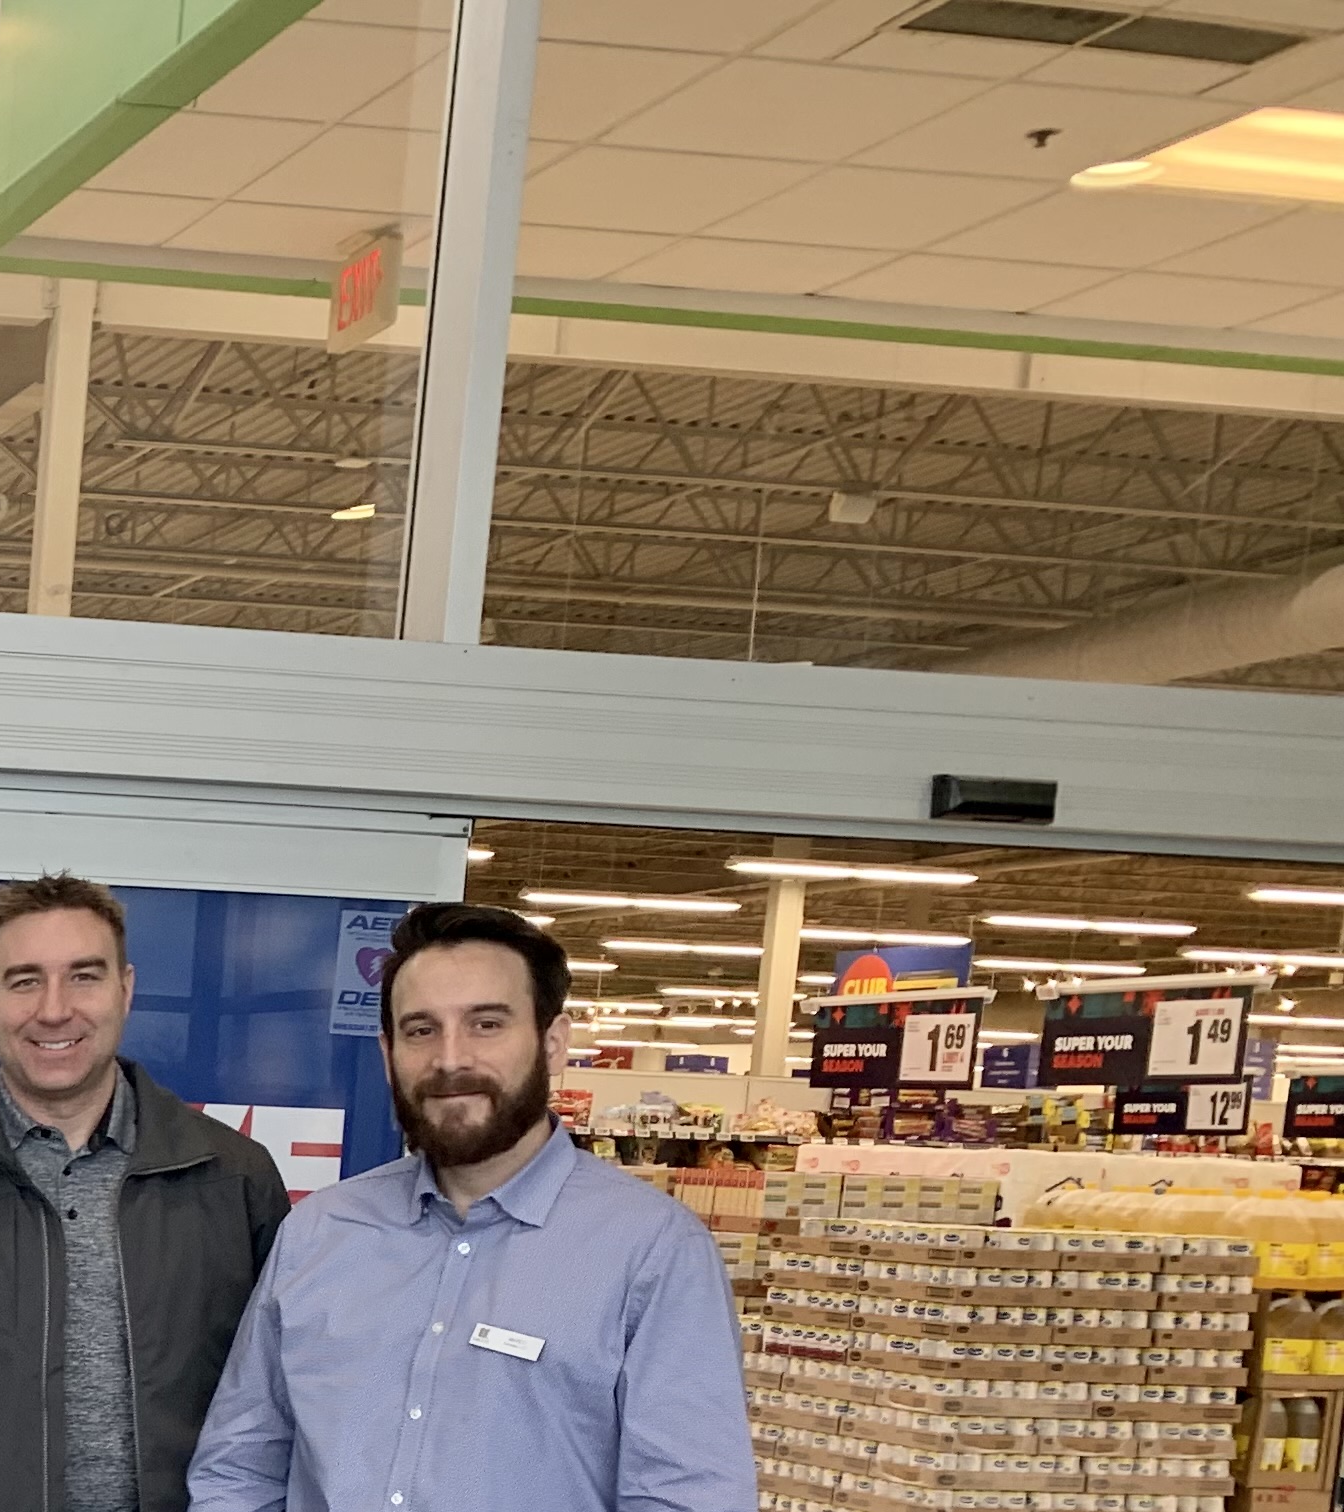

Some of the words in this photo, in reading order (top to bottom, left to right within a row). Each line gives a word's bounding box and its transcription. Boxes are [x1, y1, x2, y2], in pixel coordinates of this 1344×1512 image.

[338, 990, 380, 1006] DE
[823, 1043, 858, 1057] SUPER
[858, 1043, 887, 1057] YOUR
[1054, 1036, 1095, 1052] SUPER
[1094, 1034, 1133, 1050] YOUR
[821, 1059, 865, 1073] SEASON
[1052, 1053, 1104, 1069] SEASON
[1123, 1103, 1152, 1113] SUPER
[1153, 1103, 1177, 1113] YOUR
[1296, 1104, 1328, 1115] SUPER
